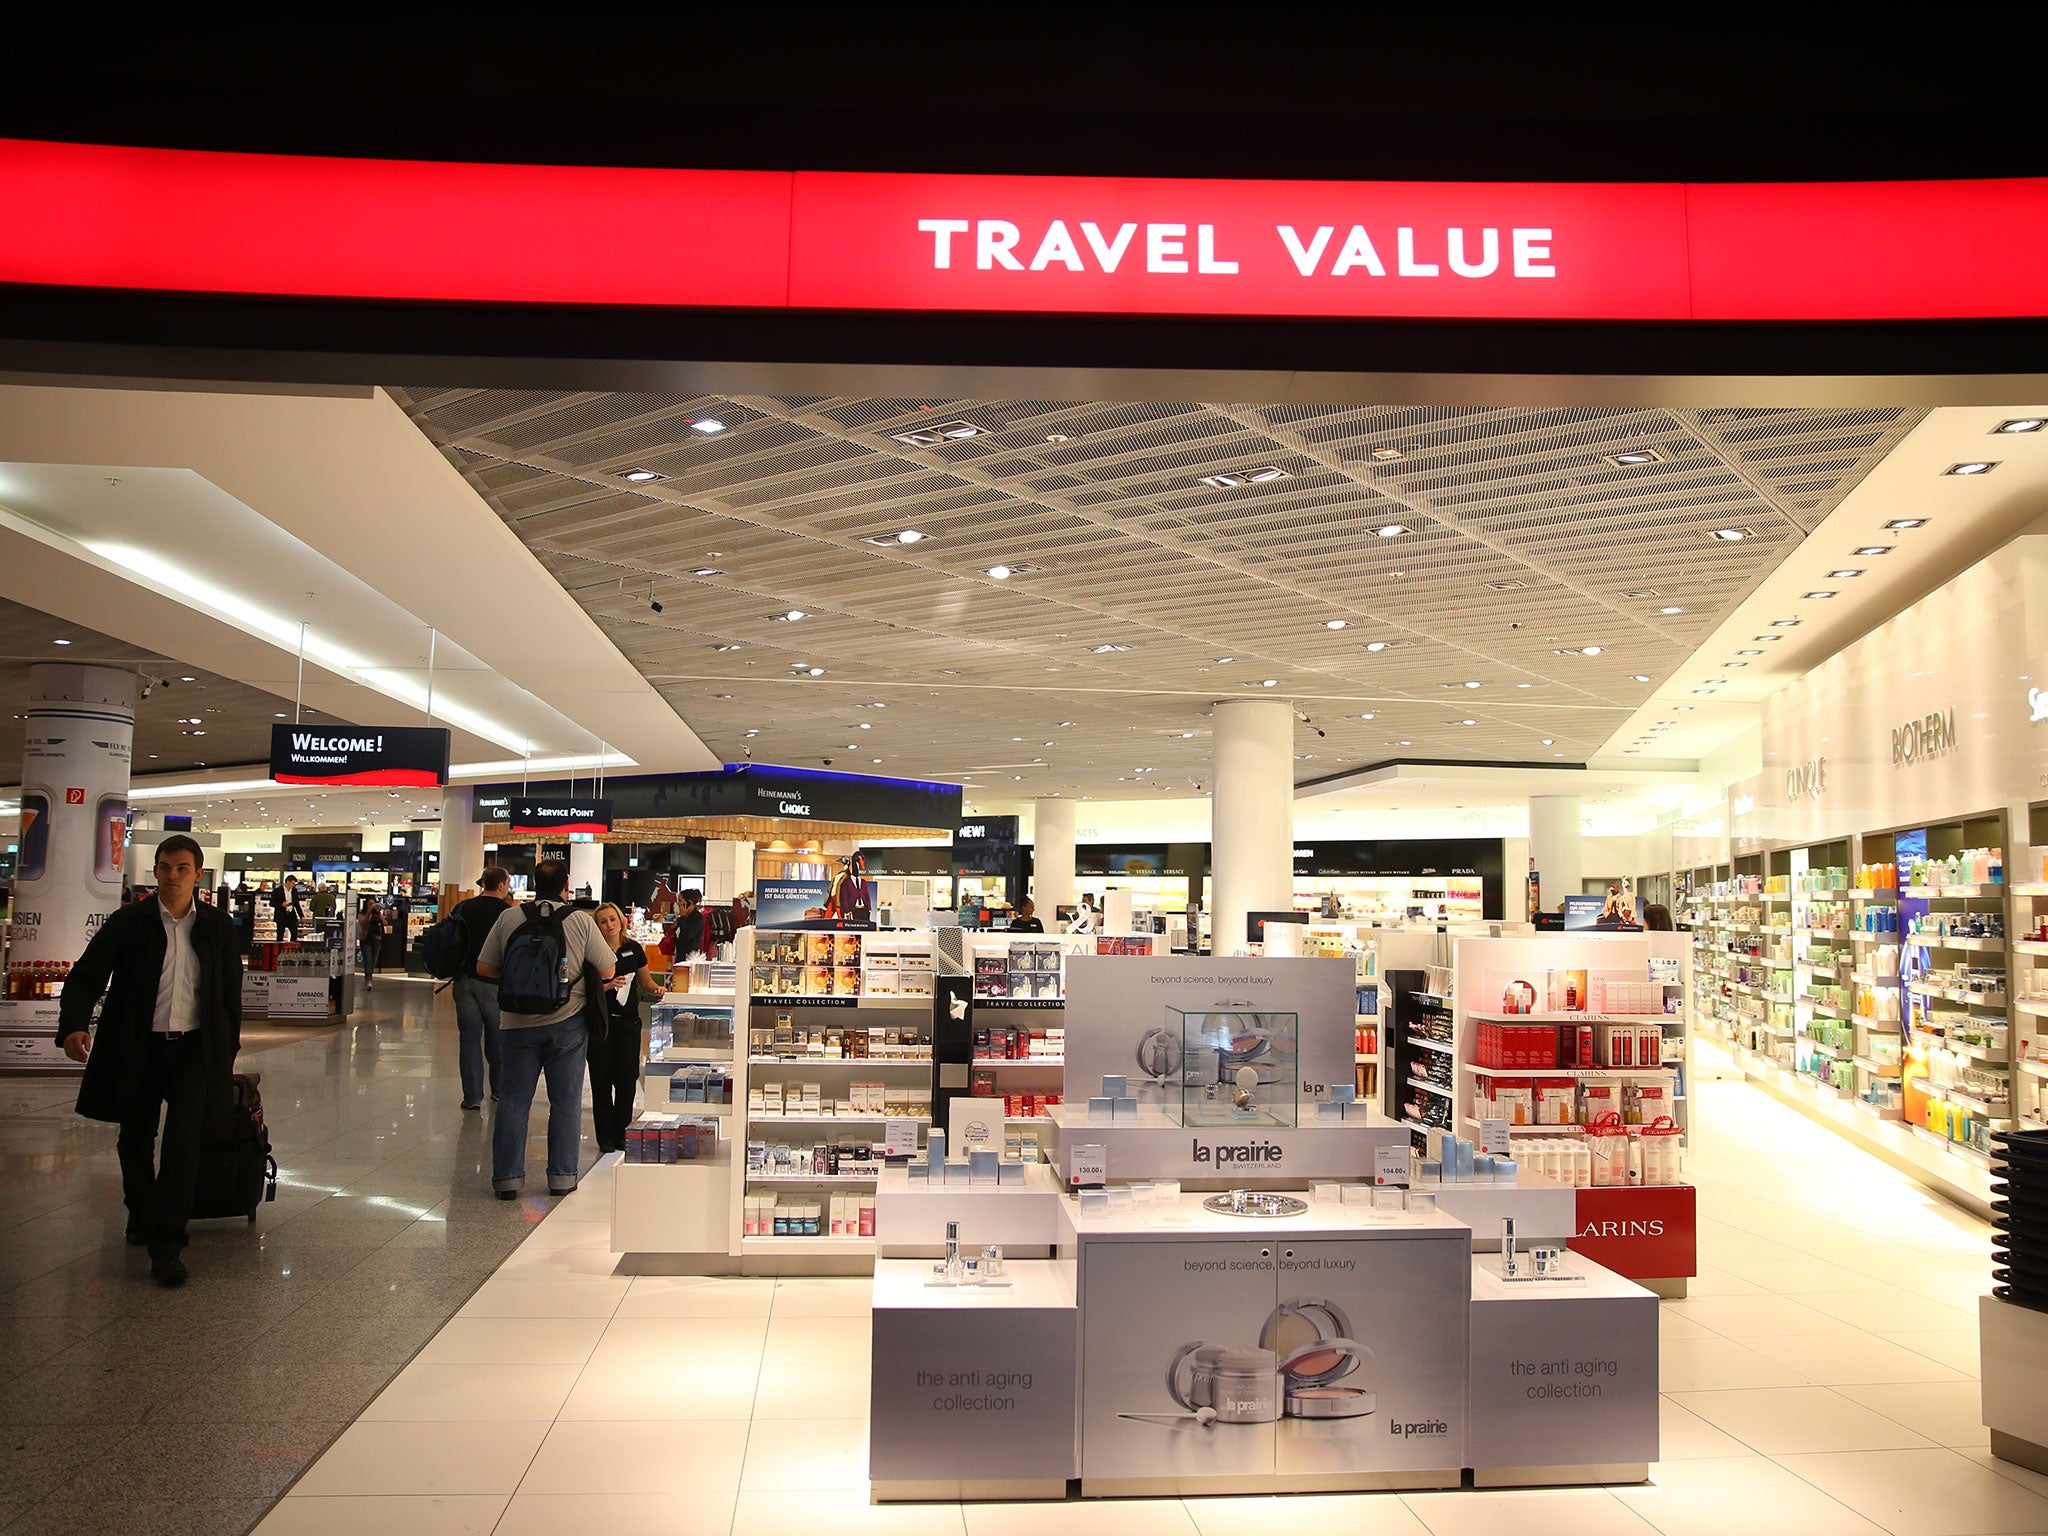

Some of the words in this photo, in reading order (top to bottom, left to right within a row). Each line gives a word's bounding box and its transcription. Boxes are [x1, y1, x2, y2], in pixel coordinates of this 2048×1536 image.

[918, 219, 1240, 275] TRAVEL
[1276, 224, 1556, 279] VALUE
[292, 733, 383, 753] WELCOME!
[1892, 705, 1956, 765] BIOTHERM
[291, 753, 348, 764] WILLKOMMEN!
[758, 788, 802, 800] HEINEMANN'S
[493, 807, 511, 819] CHOIC
[537, 807, 569, 817] SERVICE
[570, 807, 595, 818] POINT
[779, 801, 811, 815] CHOICE
[959, 825, 985, 838] NEW!
[541, 850, 566, 861] HANEL
[1151, 975, 1181, 985] beyond
[1183, 975, 1216, 985] science,
[1218, 975, 1248, 985] beyond
[1250, 975, 1274, 985] luxury
[1192, 1138, 1210, 1162] la
[1215, 1140, 1282, 1169] prairie
[1576, 1219, 1664, 1237] ARINS
[1184, 1259, 1226, 1272] beyond
[1229, 1259, 1276, 1271] science,
[1279, 1258, 1321, 1272] beyond
[1323, 1258, 1356, 1271] luxury
[1510, 1360, 1536, 1376] the
[1540, 1359, 1569, 1375] anti
[1574, 1357, 1617, 1377] aging
[917, 1370, 944, 1386] the
[949, 1370, 980, 1386] anti
[985, 1370, 1033, 1390] aging
[1526, 1382, 1602, 1399] collection
[933, 1394, 1015, 1411] collection
[1390, 1419, 1401, 1435] la
[1405, 1419, 1448, 1438] prairie
